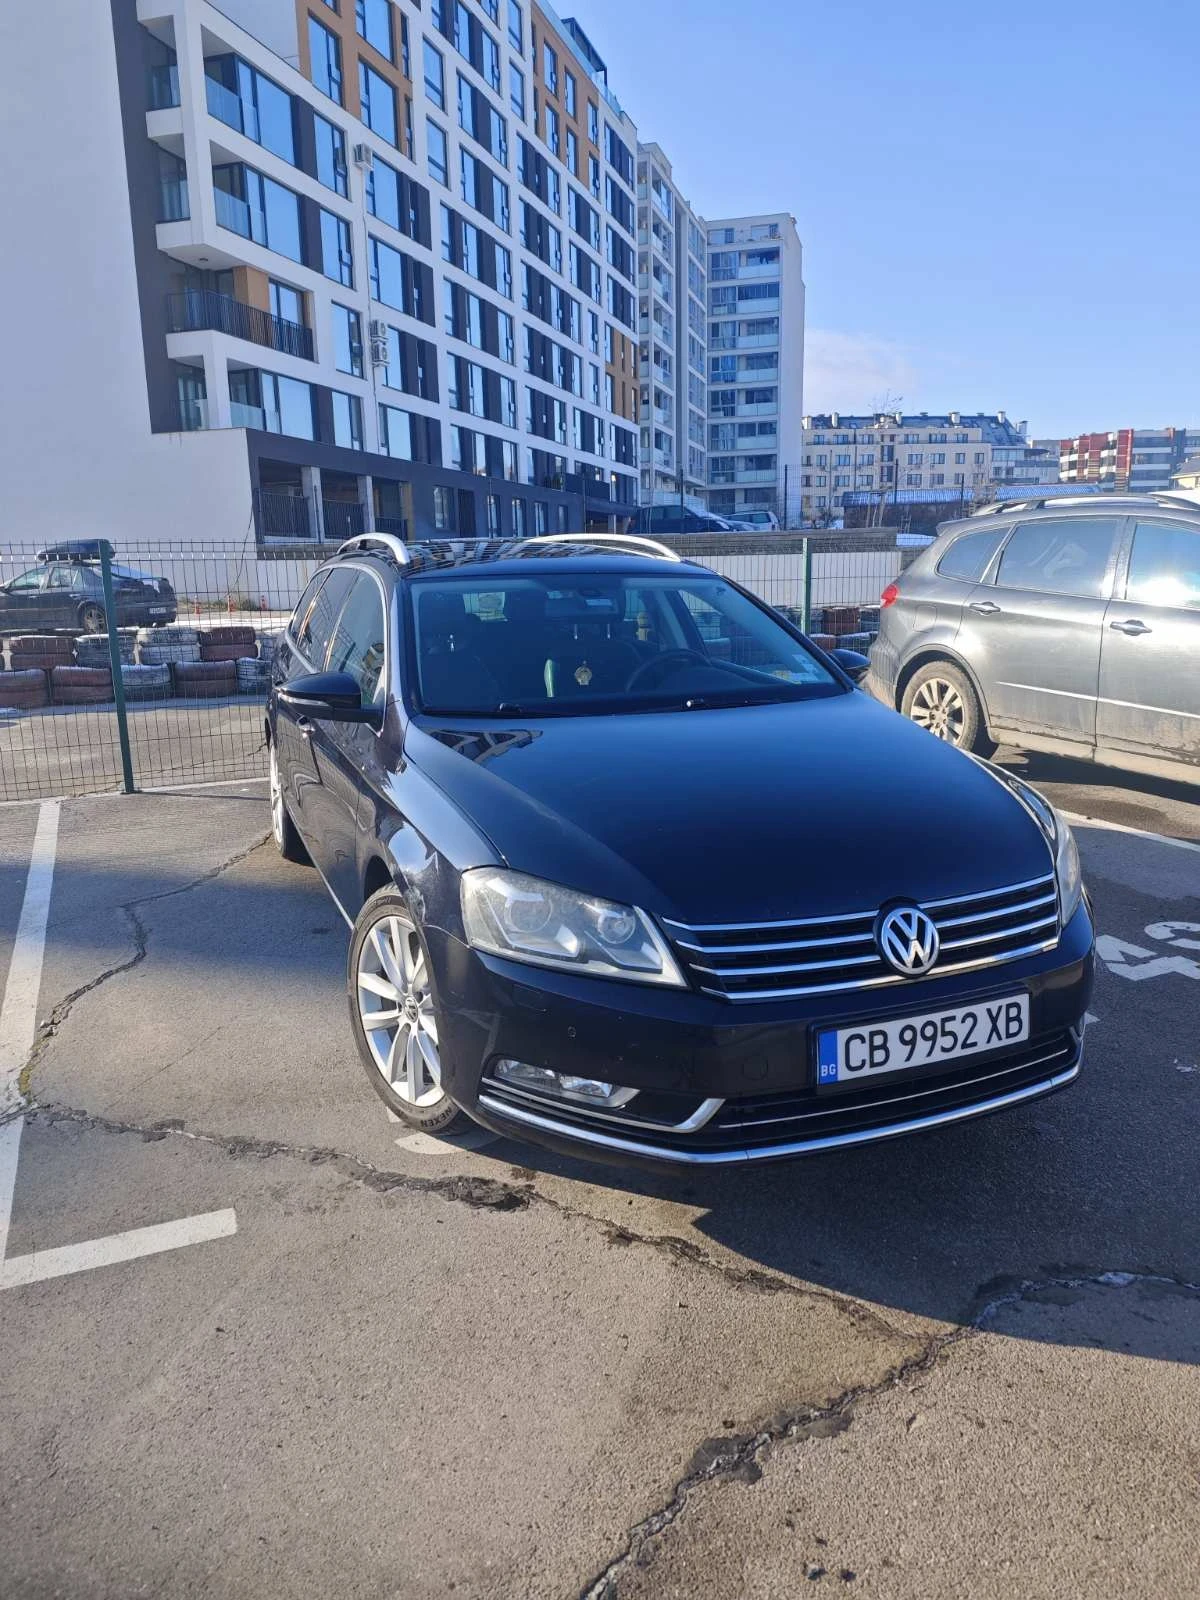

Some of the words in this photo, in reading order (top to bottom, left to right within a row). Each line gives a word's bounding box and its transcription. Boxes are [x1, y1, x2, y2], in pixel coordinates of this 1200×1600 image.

[844, 1030, 890, 1072] CB
[898, 1012, 978, 1062] 9952
[986, 1002, 1023, 1045] XB
[821, 1065, 836, 1077] BG
[420, 1106, 452, 1127] NEXEN
